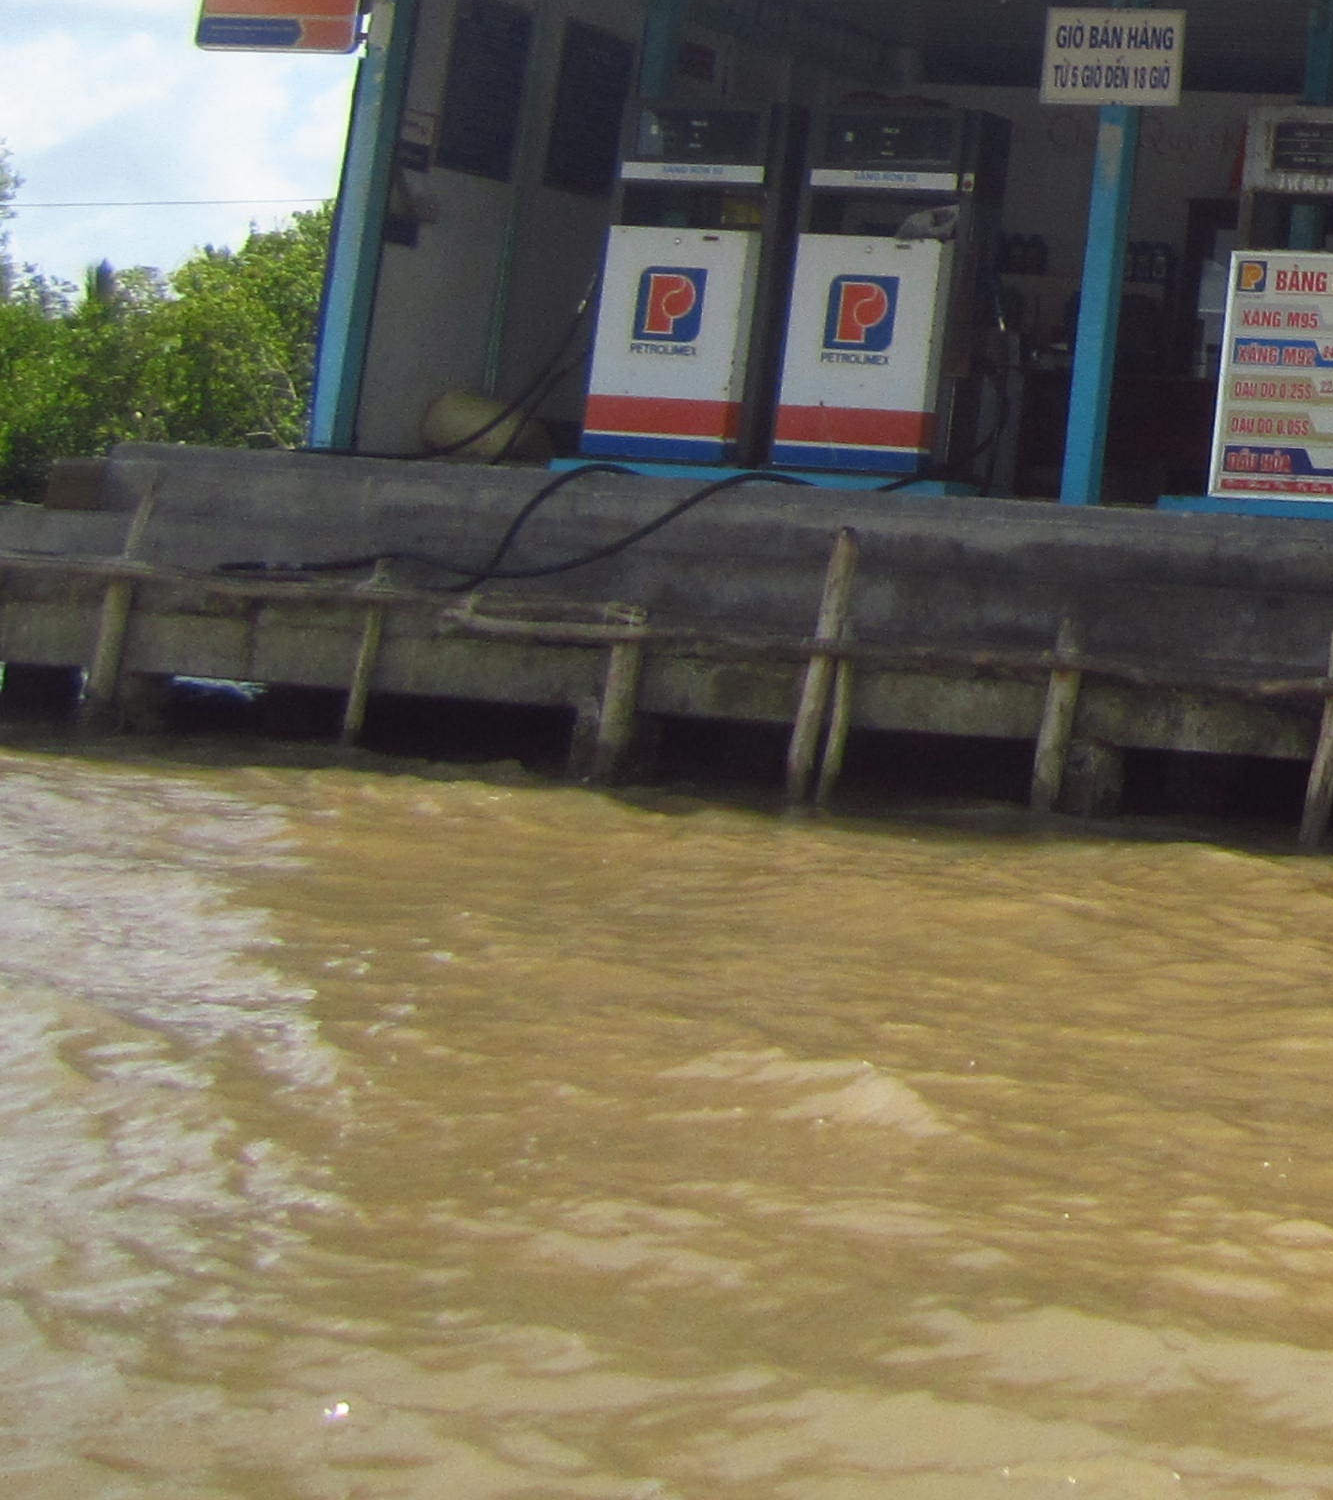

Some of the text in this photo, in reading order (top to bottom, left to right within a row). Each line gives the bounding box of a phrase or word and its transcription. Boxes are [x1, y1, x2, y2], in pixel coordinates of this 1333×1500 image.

[1056, 18, 1174, 50] GIỜ BÁN HÀNG
[1082, 58, 1102, 88] GIỜ
[1134, 66, 1147, 89] 18
[1149, 59, 1171, 89] GIỜ
[1275, 264, 1328, 292] BẢNG
[1287, 311, 1319, 329] M95
[630, 342, 697, 358] PETROLIMEX
[820, 351, 890, 367] PETROLIMEX
[1283, 347, 1316, 366] M92
